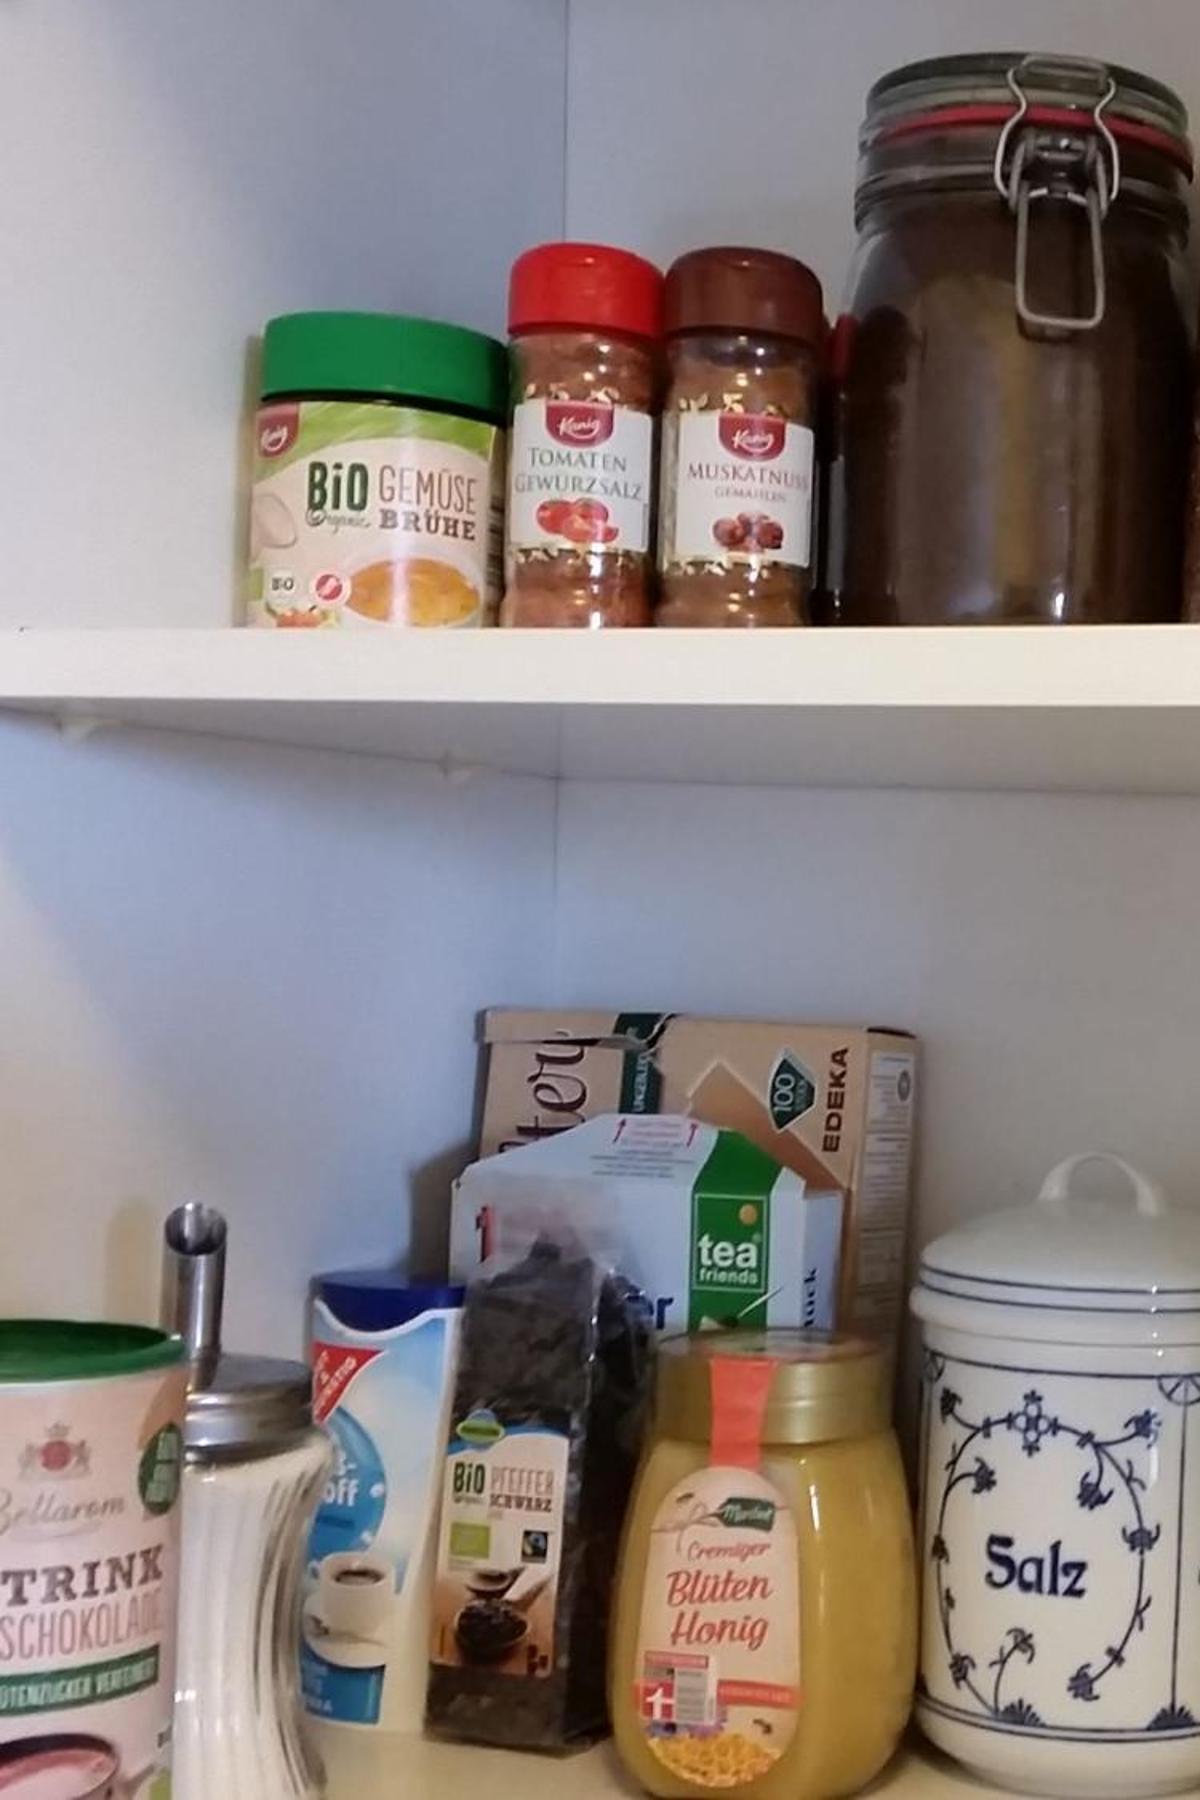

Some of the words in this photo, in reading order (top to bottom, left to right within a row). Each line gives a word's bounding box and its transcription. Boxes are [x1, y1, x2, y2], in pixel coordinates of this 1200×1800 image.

[529, 447, 627, 473] TOMATEN
[379, 465, 478, 516] GEMÜSE
[514, 472, 642, 501] GEWÜRZSALZ
[378, 507, 477, 541] BRÜHE
[772, 1072, 797, 1113] 100
[821, 1047, 849, 1153] EDEKA
[697, 1232, 759, 1269] tea
[699, 1267, 759, 1285] friends
[491, 1465, 555, 1496] PFEFFER
[489, 1493, 553, 1513] SCHWARZ
[687, 1540, 771, 1562] Cremiger
[984, 1533, 1089, 1599] Salz
[0, 1543, 163, 1607] TRINK
[666, 1569, 774, 1608] Blüten
[670, 1610, 769, 1651] Honig
